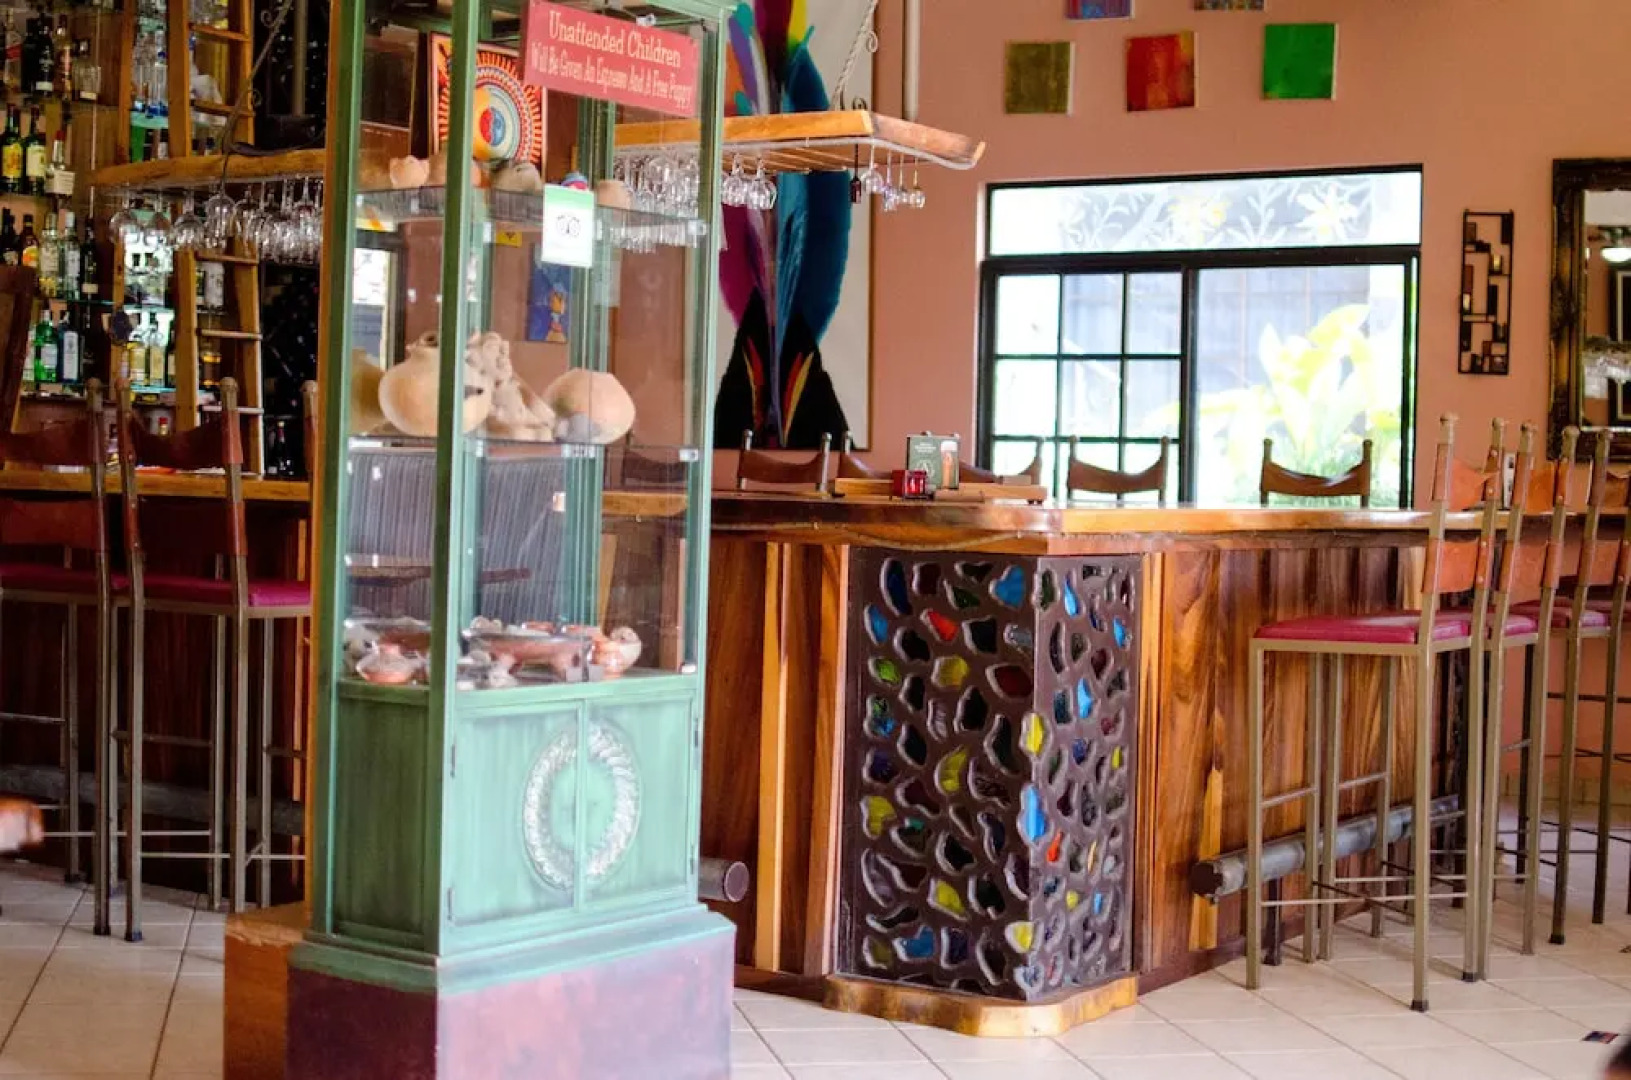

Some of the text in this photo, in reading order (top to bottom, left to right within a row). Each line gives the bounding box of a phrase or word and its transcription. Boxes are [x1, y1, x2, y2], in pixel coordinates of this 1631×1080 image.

[549, 10, 681, 68] Unattended Children
[560, 48, 582, 81] Given
[628, 64, 643, 93] And
[652, 69, 668, 99] Free
